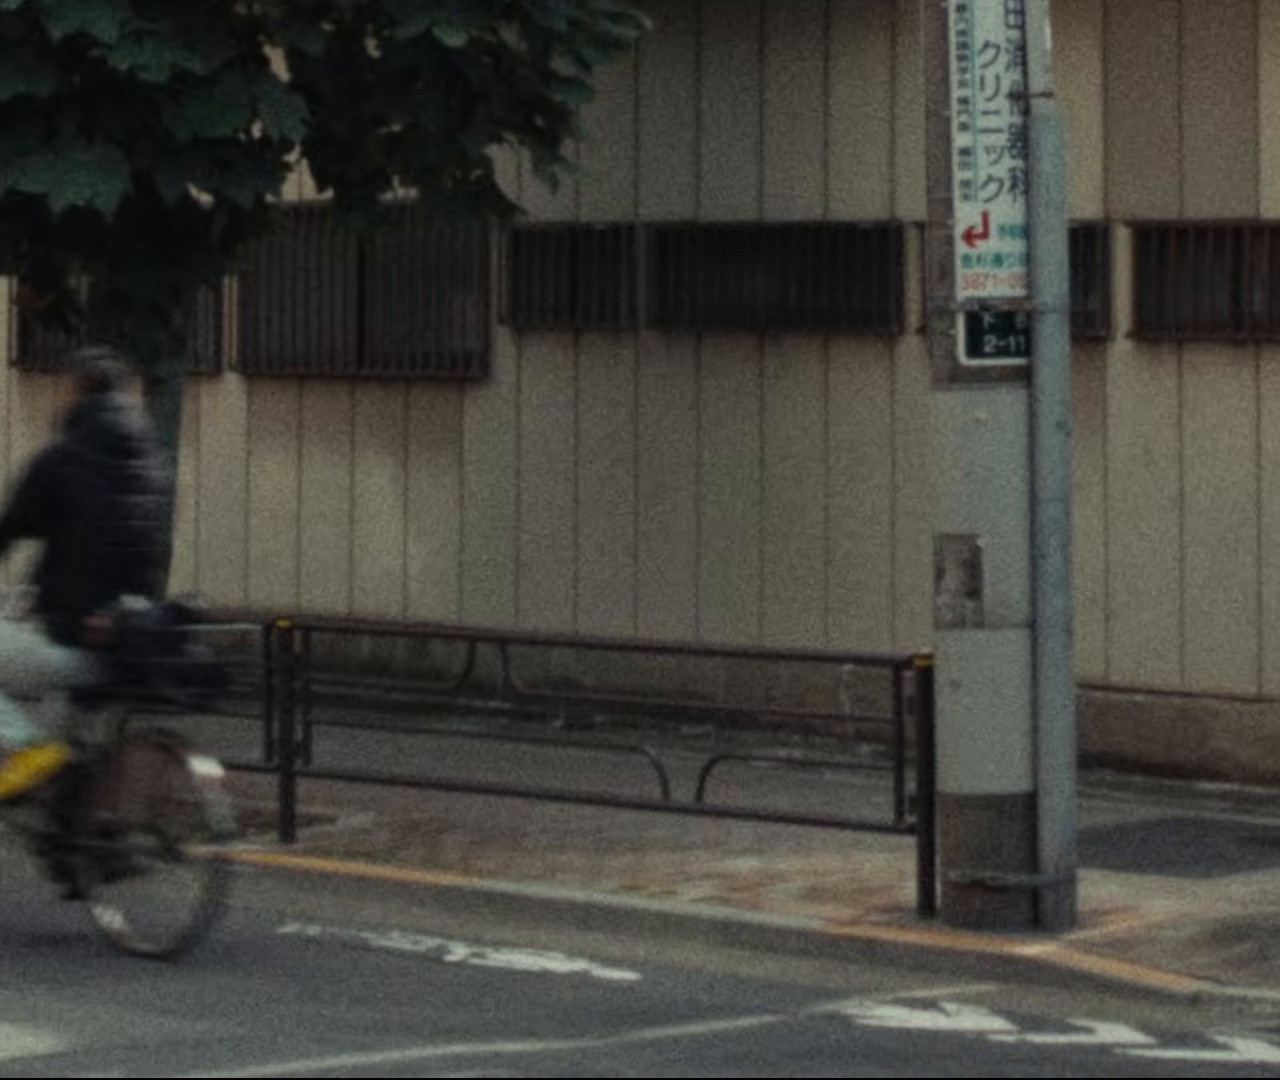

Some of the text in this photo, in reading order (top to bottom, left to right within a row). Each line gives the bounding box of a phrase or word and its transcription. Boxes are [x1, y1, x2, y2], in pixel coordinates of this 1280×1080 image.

[976, 39, 1004, 204] クリニック
